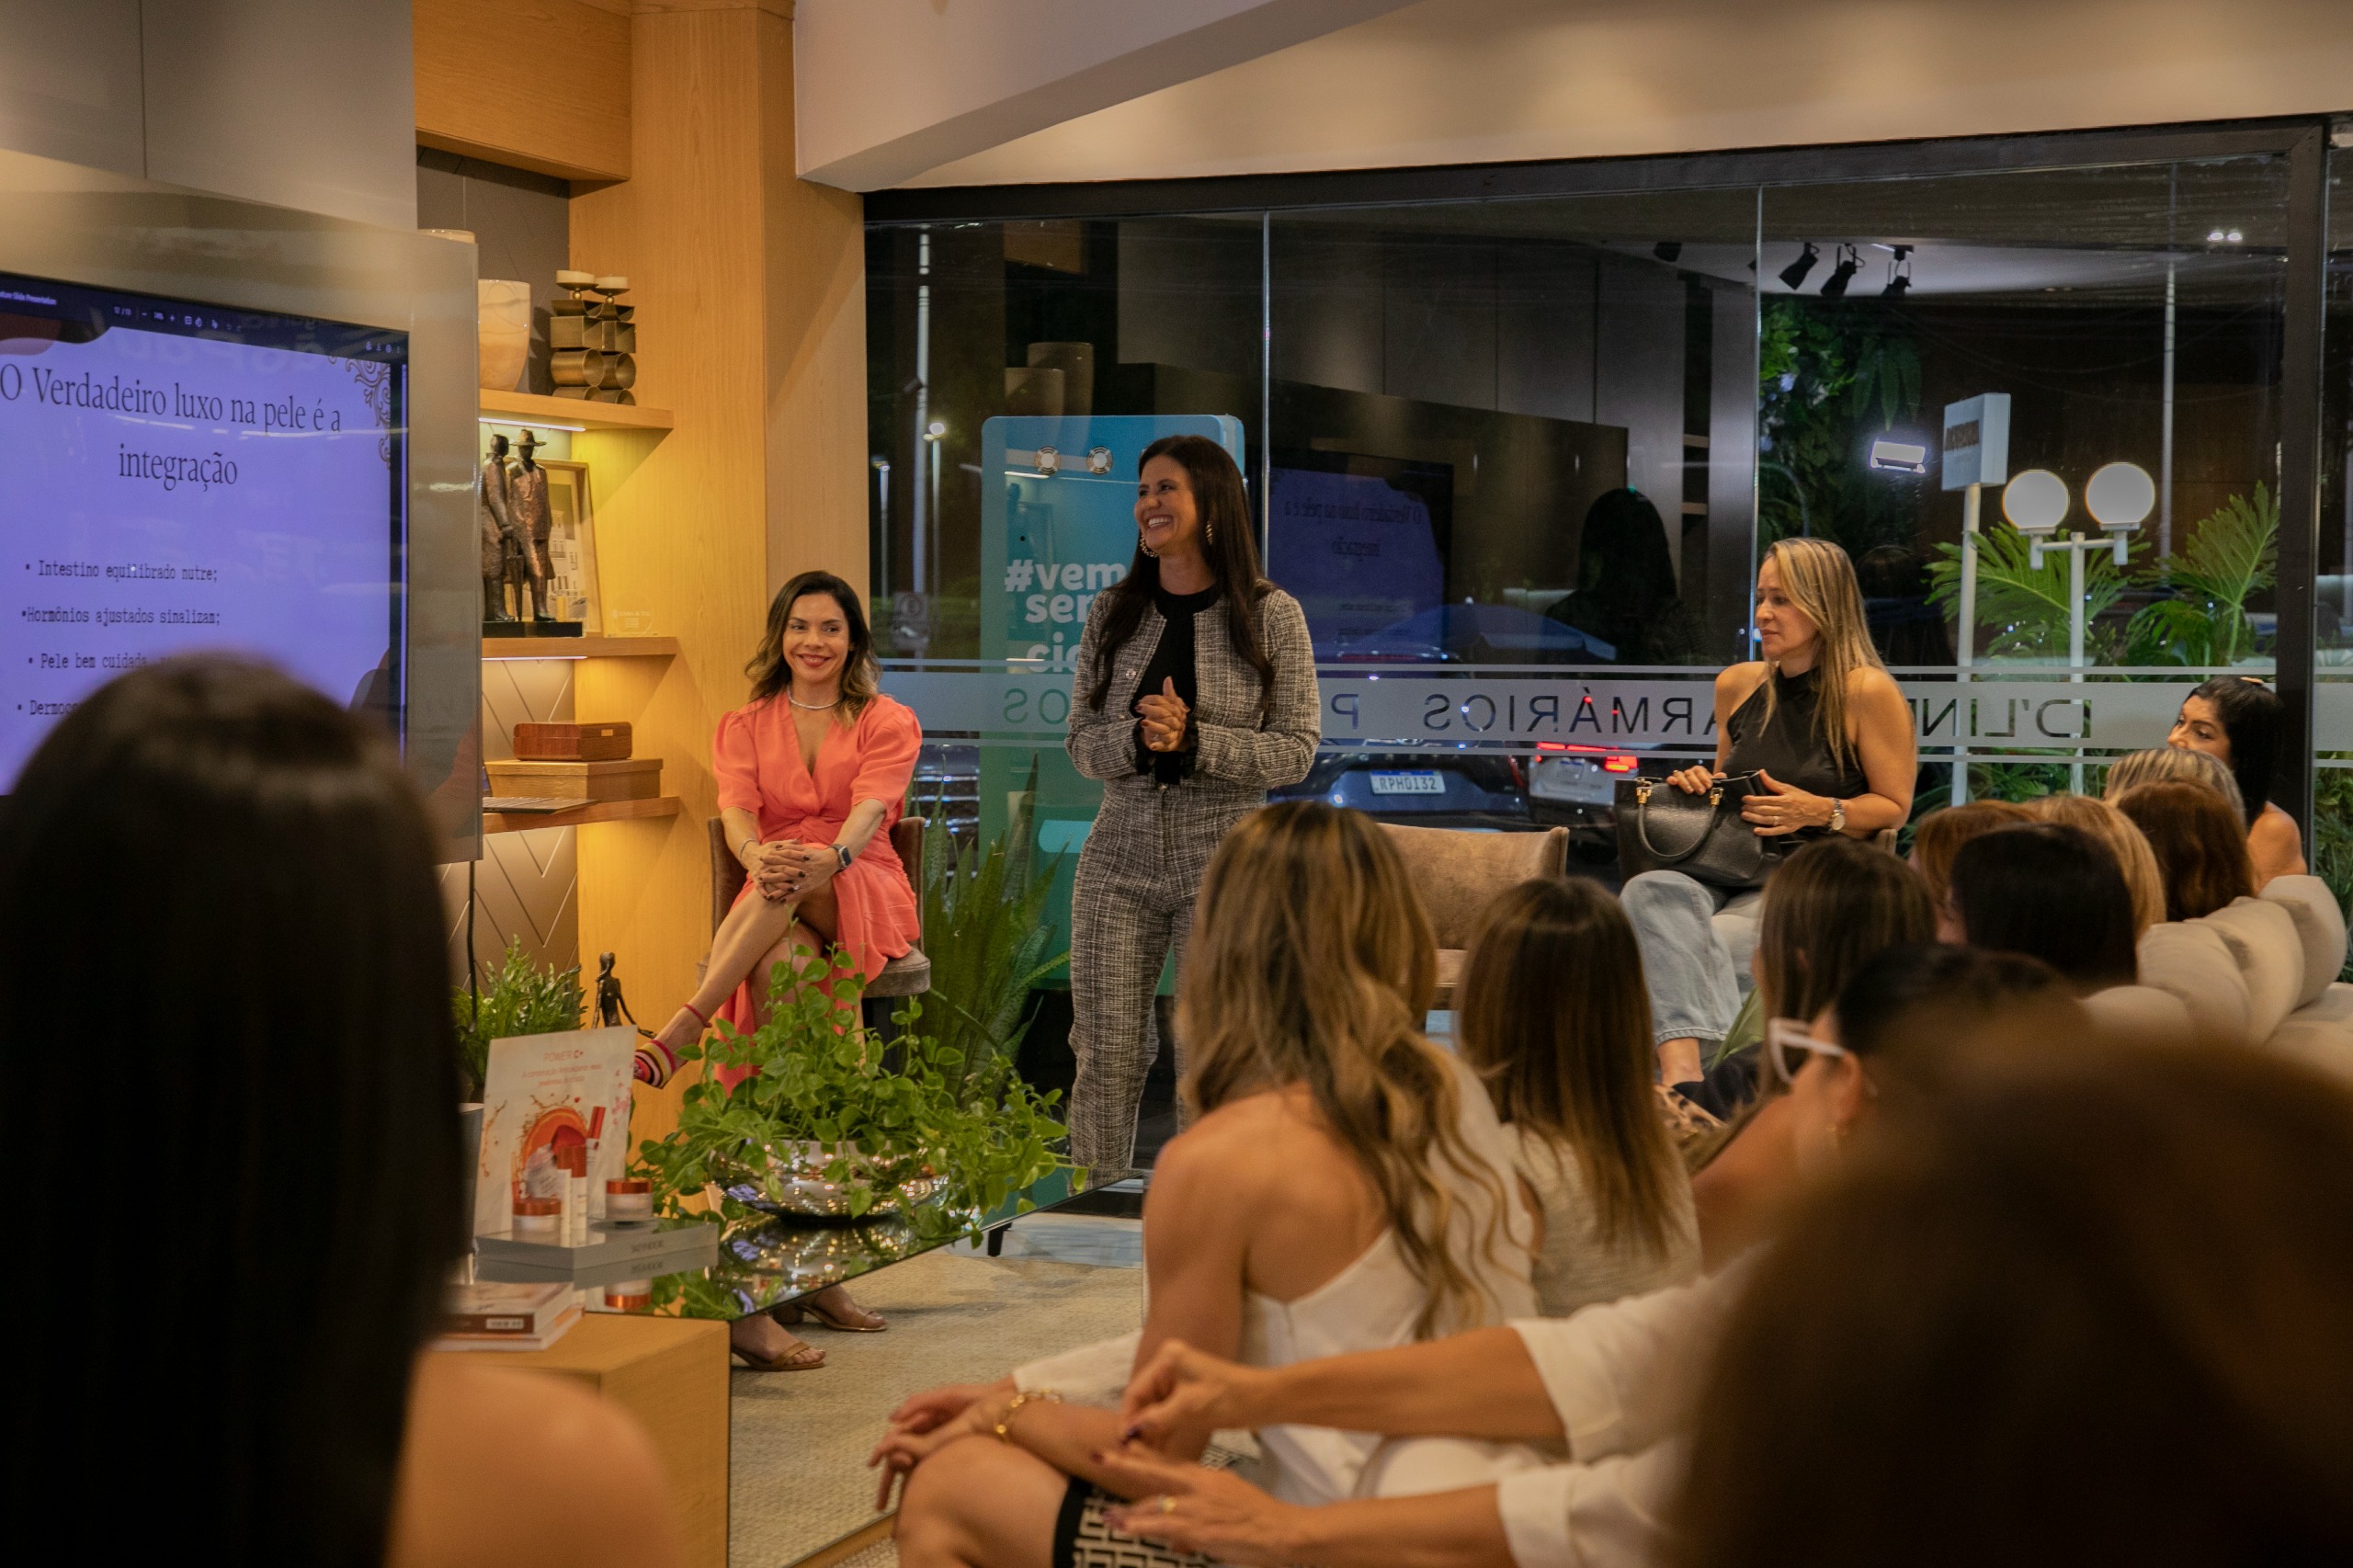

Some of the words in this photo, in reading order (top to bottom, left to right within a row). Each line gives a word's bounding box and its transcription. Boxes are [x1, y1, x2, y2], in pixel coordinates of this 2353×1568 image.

[1, 364, 22, 401] O
[31, 367, 166, 415] Verdadeiro
[175, 383, 222, 421] luxo
[231, 398, 256, 425] na
[264, 395, 305, 433] pele
[313, 399, 324, 432] é
[331, 408, 341, 432] a
[119, 443, 237, 492] integração
[39, 560, 99, 577] Intestino
[107, 563, 176, 582] equilibrado
[182, 565, 218, 583] nutre;
[1004, 559, 1127, 592] #vem
[27, 607, 89, 623] Hormônios
[96, 608, 154, 627] ajustados
[160, 610, 221, 626] sinalizam;
[40, 653, 69, 669] Pele
[75, 653, 96, 669] bem
